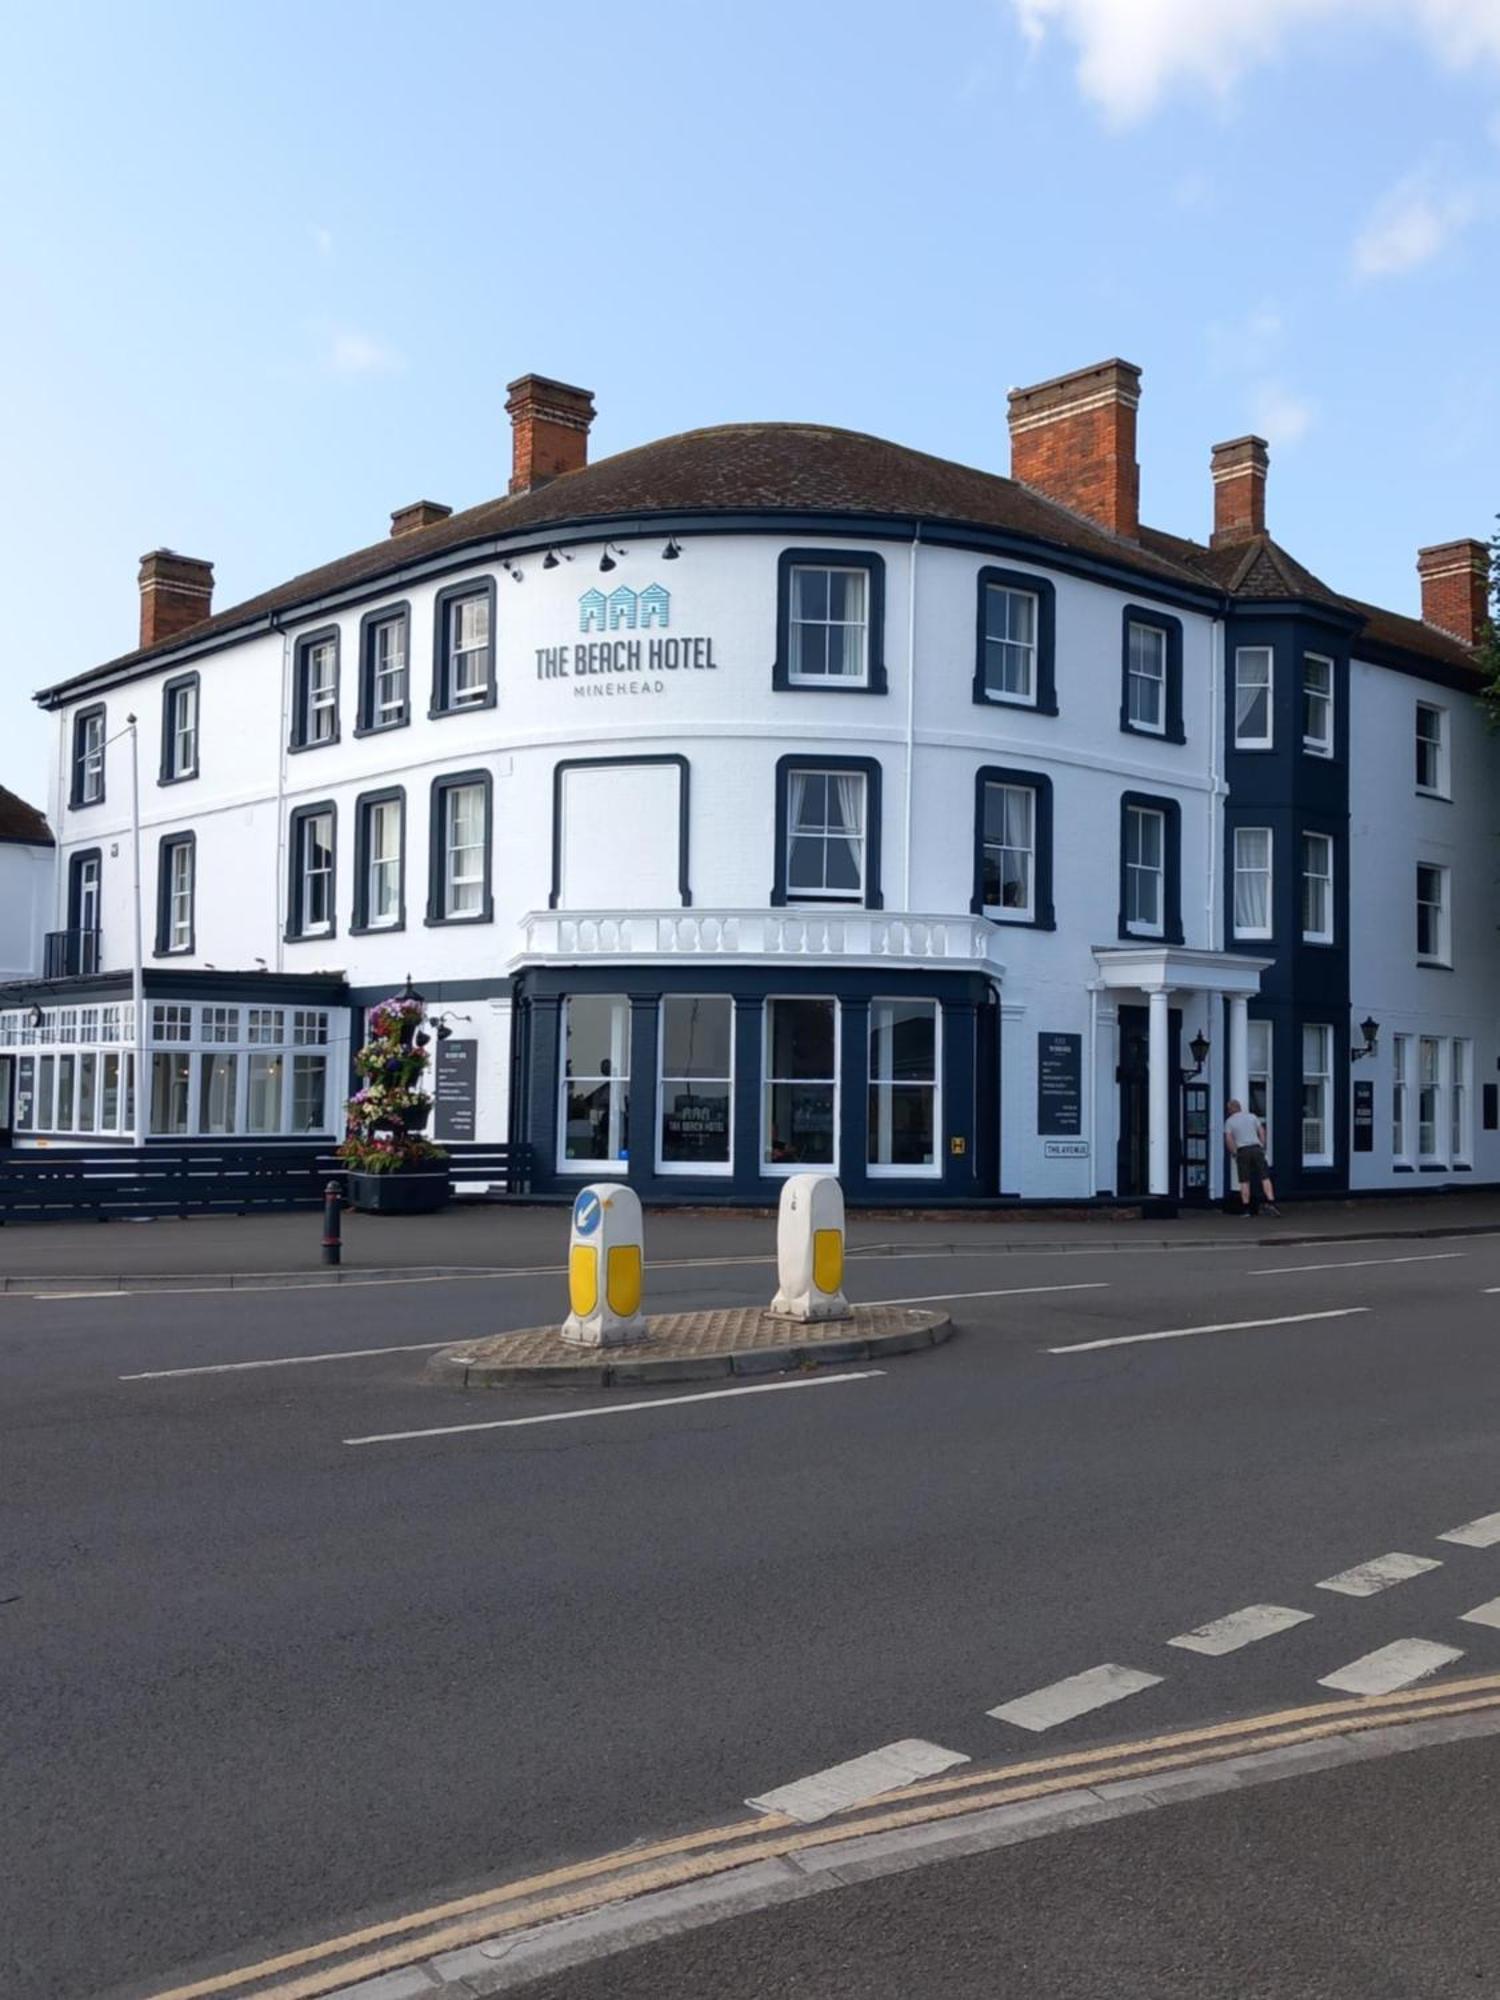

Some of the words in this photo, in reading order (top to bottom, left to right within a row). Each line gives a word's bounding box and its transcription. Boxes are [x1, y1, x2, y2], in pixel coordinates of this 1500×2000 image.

[535, 647, 569, 680] THE
[574, 639, 641, 676] BEACH
[649, 637, 717, 670] HOTEL
[574, 681, 664, 697] MINEHEAD
